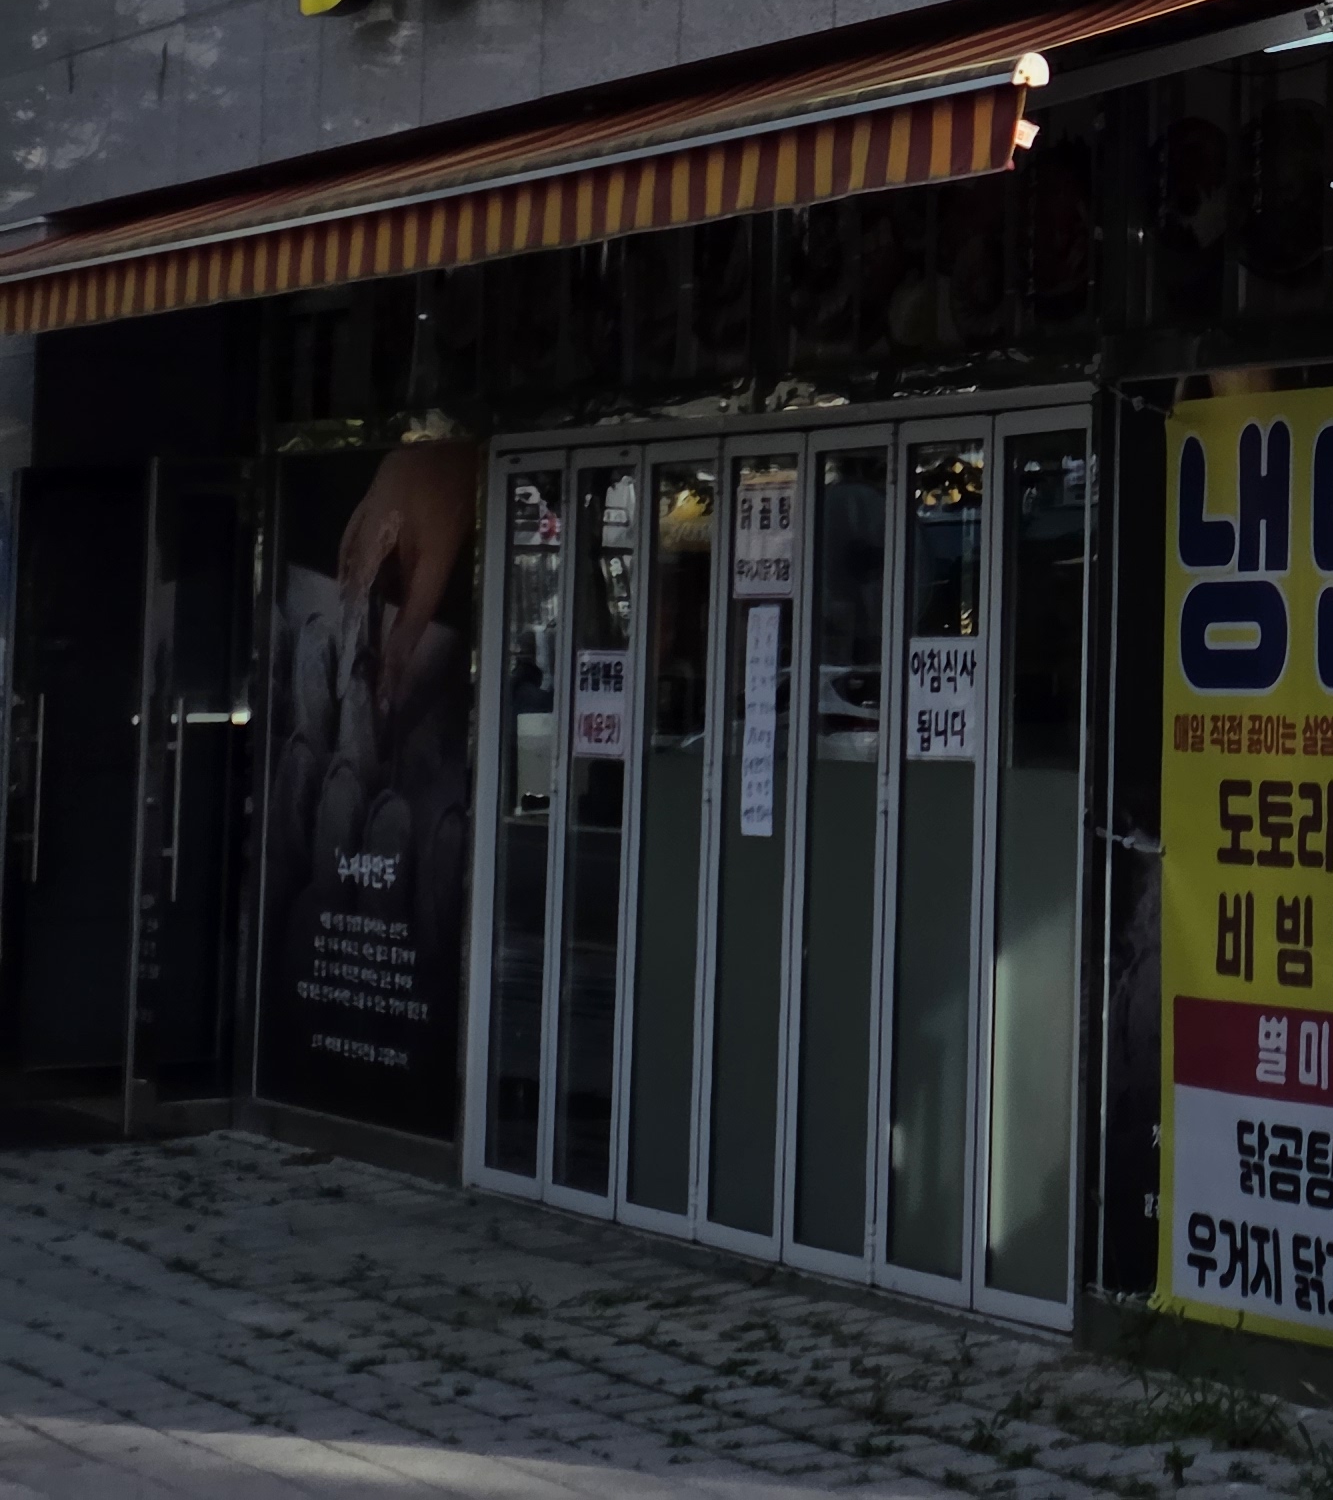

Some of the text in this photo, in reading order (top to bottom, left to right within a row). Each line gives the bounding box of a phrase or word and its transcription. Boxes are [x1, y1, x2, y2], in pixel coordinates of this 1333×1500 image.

[911, 648, 977, 694] 아침식사
[916, 709, 966, 752] 됩니다
[1174, 713, 1205, 752] 매일
[1210, 713, 1243, 754] 직접
[1247, 714, 1297, 755] 끓이는
[1256, 1014, 1331, 1091] 별미
[1187, 1210, 1285, 1307] 우거지
